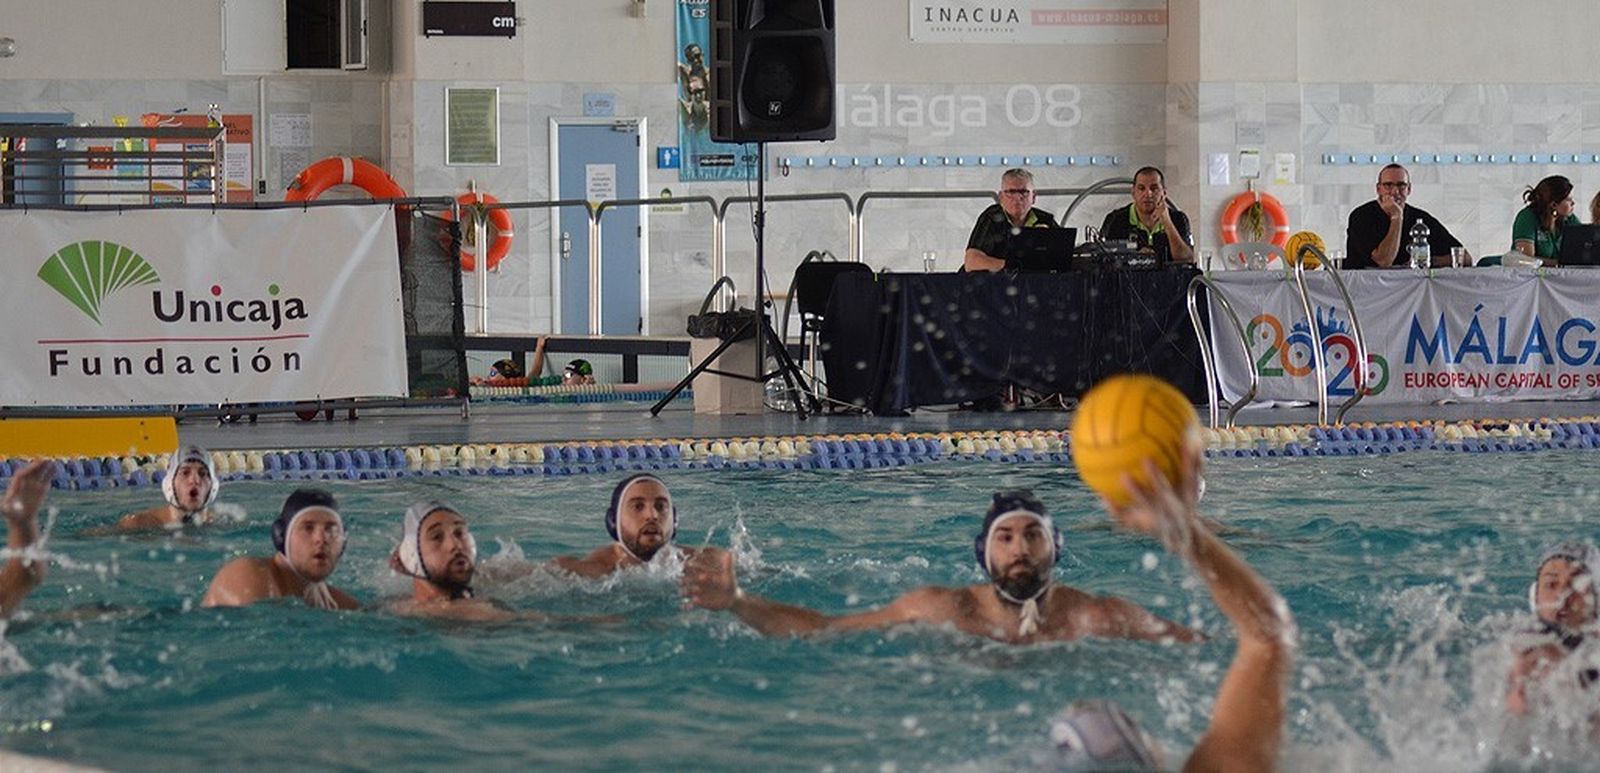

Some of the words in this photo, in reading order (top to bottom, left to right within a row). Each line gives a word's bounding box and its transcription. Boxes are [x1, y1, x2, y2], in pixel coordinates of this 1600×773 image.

[492, 16, 514, 27] cm
[924, 7, 1020, 23] INACUA
[836, 84, 988, 136] álaga
[1005, 84, 1082, 128] 08
[152, 284, 309, 331] Unicaja
[1405, 303, 1600, 367] MÁLAG
[49, 346, 301, 377] Fundación
[1404, 372, 1490, 389] EUROPEAN
[1495, 372, 1553, 389] CAPITAL
[1558, 373, 1580, 389] OF
